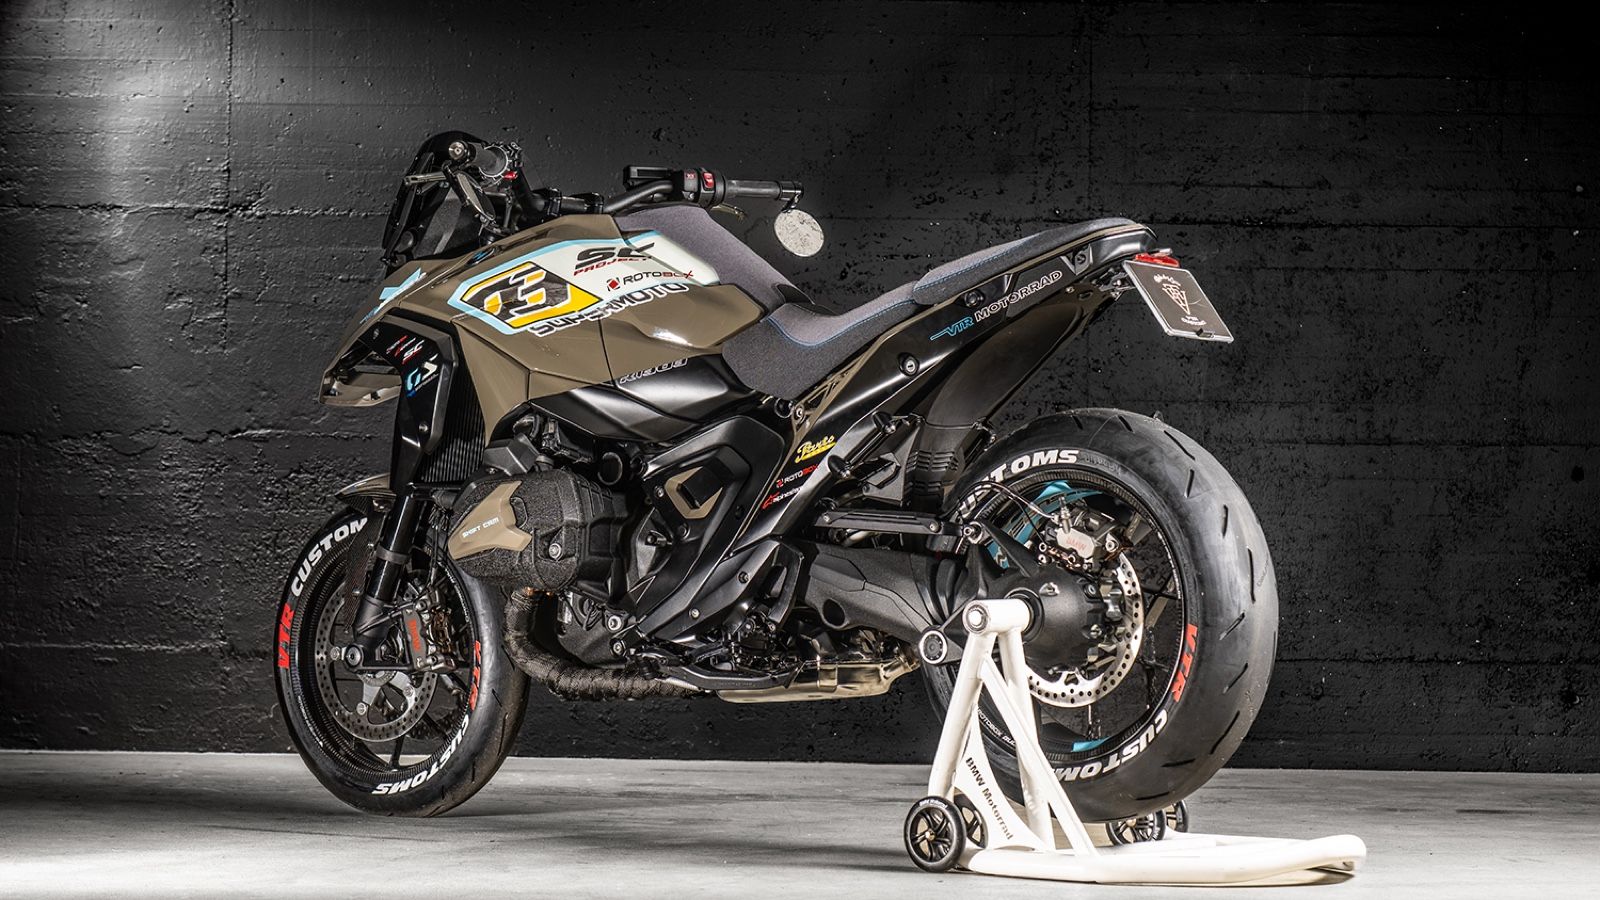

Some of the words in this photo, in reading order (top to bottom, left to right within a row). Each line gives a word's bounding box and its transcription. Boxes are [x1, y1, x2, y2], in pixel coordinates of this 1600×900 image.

[528, 282, 689, 337] SUPERMOTO
[932, 316, 974, 340] VTR
[974, 270, 1063, 322] MOTORRAD
[291, 517, 368, 597] CUSTOM
[277, 603, 295, 670] VTR
[1171, 623, 1198, 702] VTR
[469, 640, 482, 711] VTR
[371, 714, 470, 795] CUSTOMS
[1053, 708, 1169, 782] CUSTOM
[965, 757, 985, 786] BMW
[982, 787, 1014, 841] Motorrad
